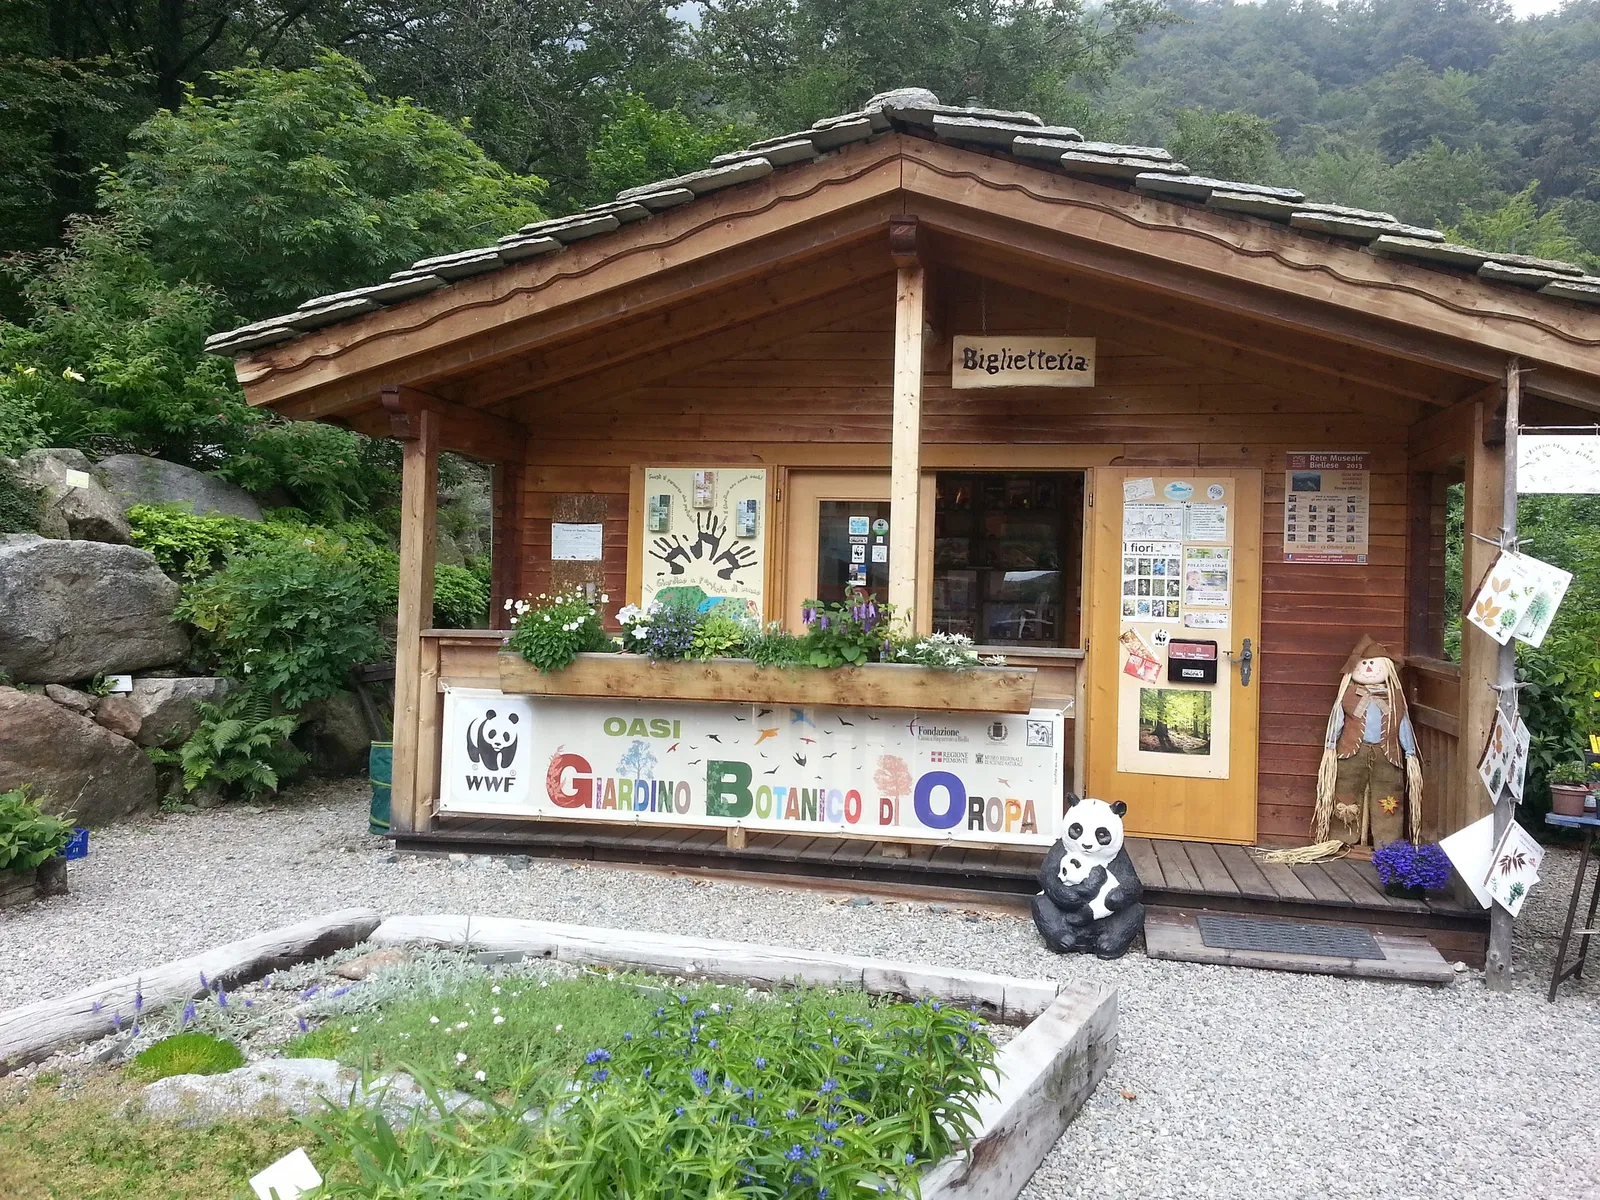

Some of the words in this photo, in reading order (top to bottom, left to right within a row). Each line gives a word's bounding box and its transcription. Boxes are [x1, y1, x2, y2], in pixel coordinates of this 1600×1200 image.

[962, 347, 1087, 375] Biglietteria
[1309, 454, 1328, 462] Rete
[1329, 454, 1364, 462] Museale
[1309, 461, 1339, 469] Biellese
[1131, 542, 1154, 553] fiori
[603, 716, 681, 739] OASI
[918, 725, 960, 737] Fondazione
[942, 751, 969, 759] REGIONE
[465, 774, 516, 794] WWF
[545, 752, 692, 815] GIARDINO
[704, 759, 862, 825] BOTANICO
[879, 796, 900, 827] DI
[914, 770, 1038, 835] OROPA
